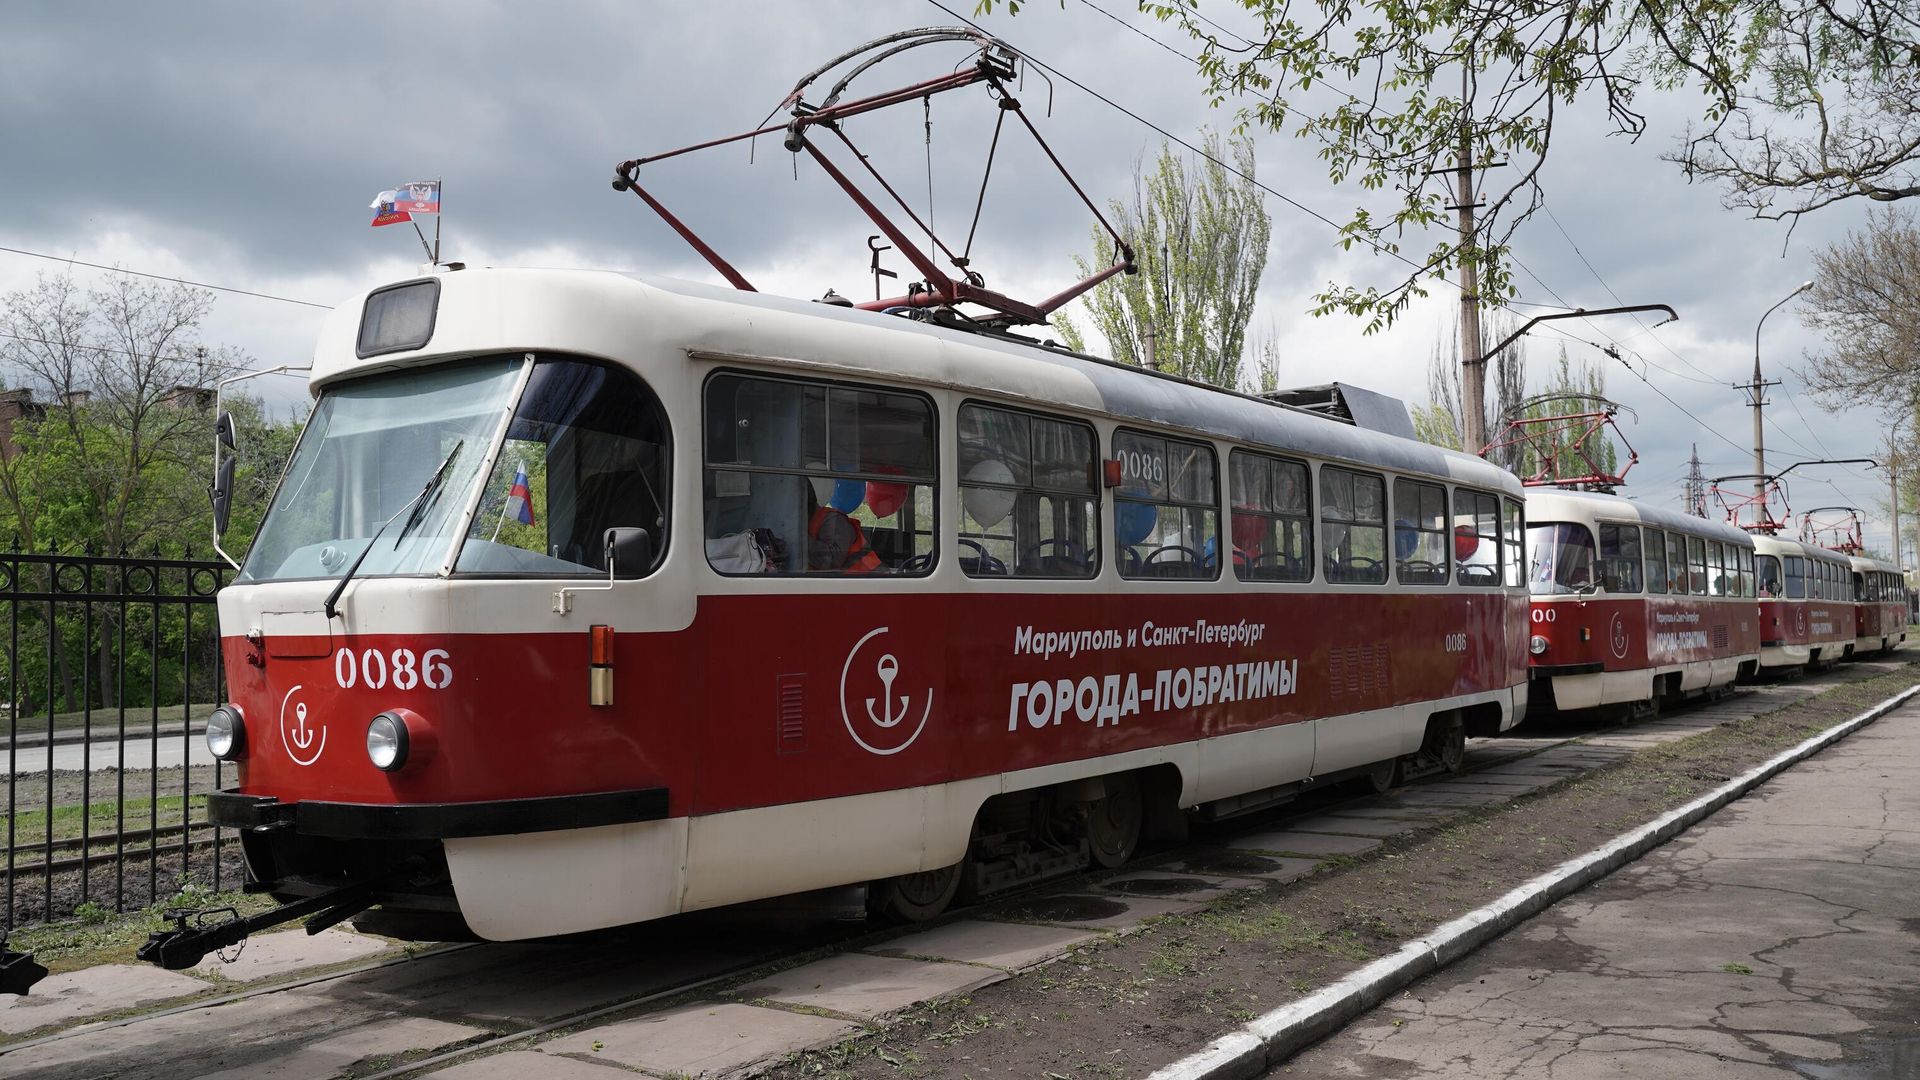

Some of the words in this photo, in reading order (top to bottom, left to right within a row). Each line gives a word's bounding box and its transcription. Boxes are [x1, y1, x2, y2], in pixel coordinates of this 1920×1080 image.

[1117, 449, 1162, 481] 0086
[1014, 625, 1122, 660] Мариуполь
[1126, 628, 1137, 648] и
[1141, 618, 1265, 648] Санкт-Петербург
[1445, 633, 1467, 652] 0086
[335, 647, 453, 690] 0086
[1008, 658, 1298, 731] ГОРОДА-ПОБРАТИМЫ
